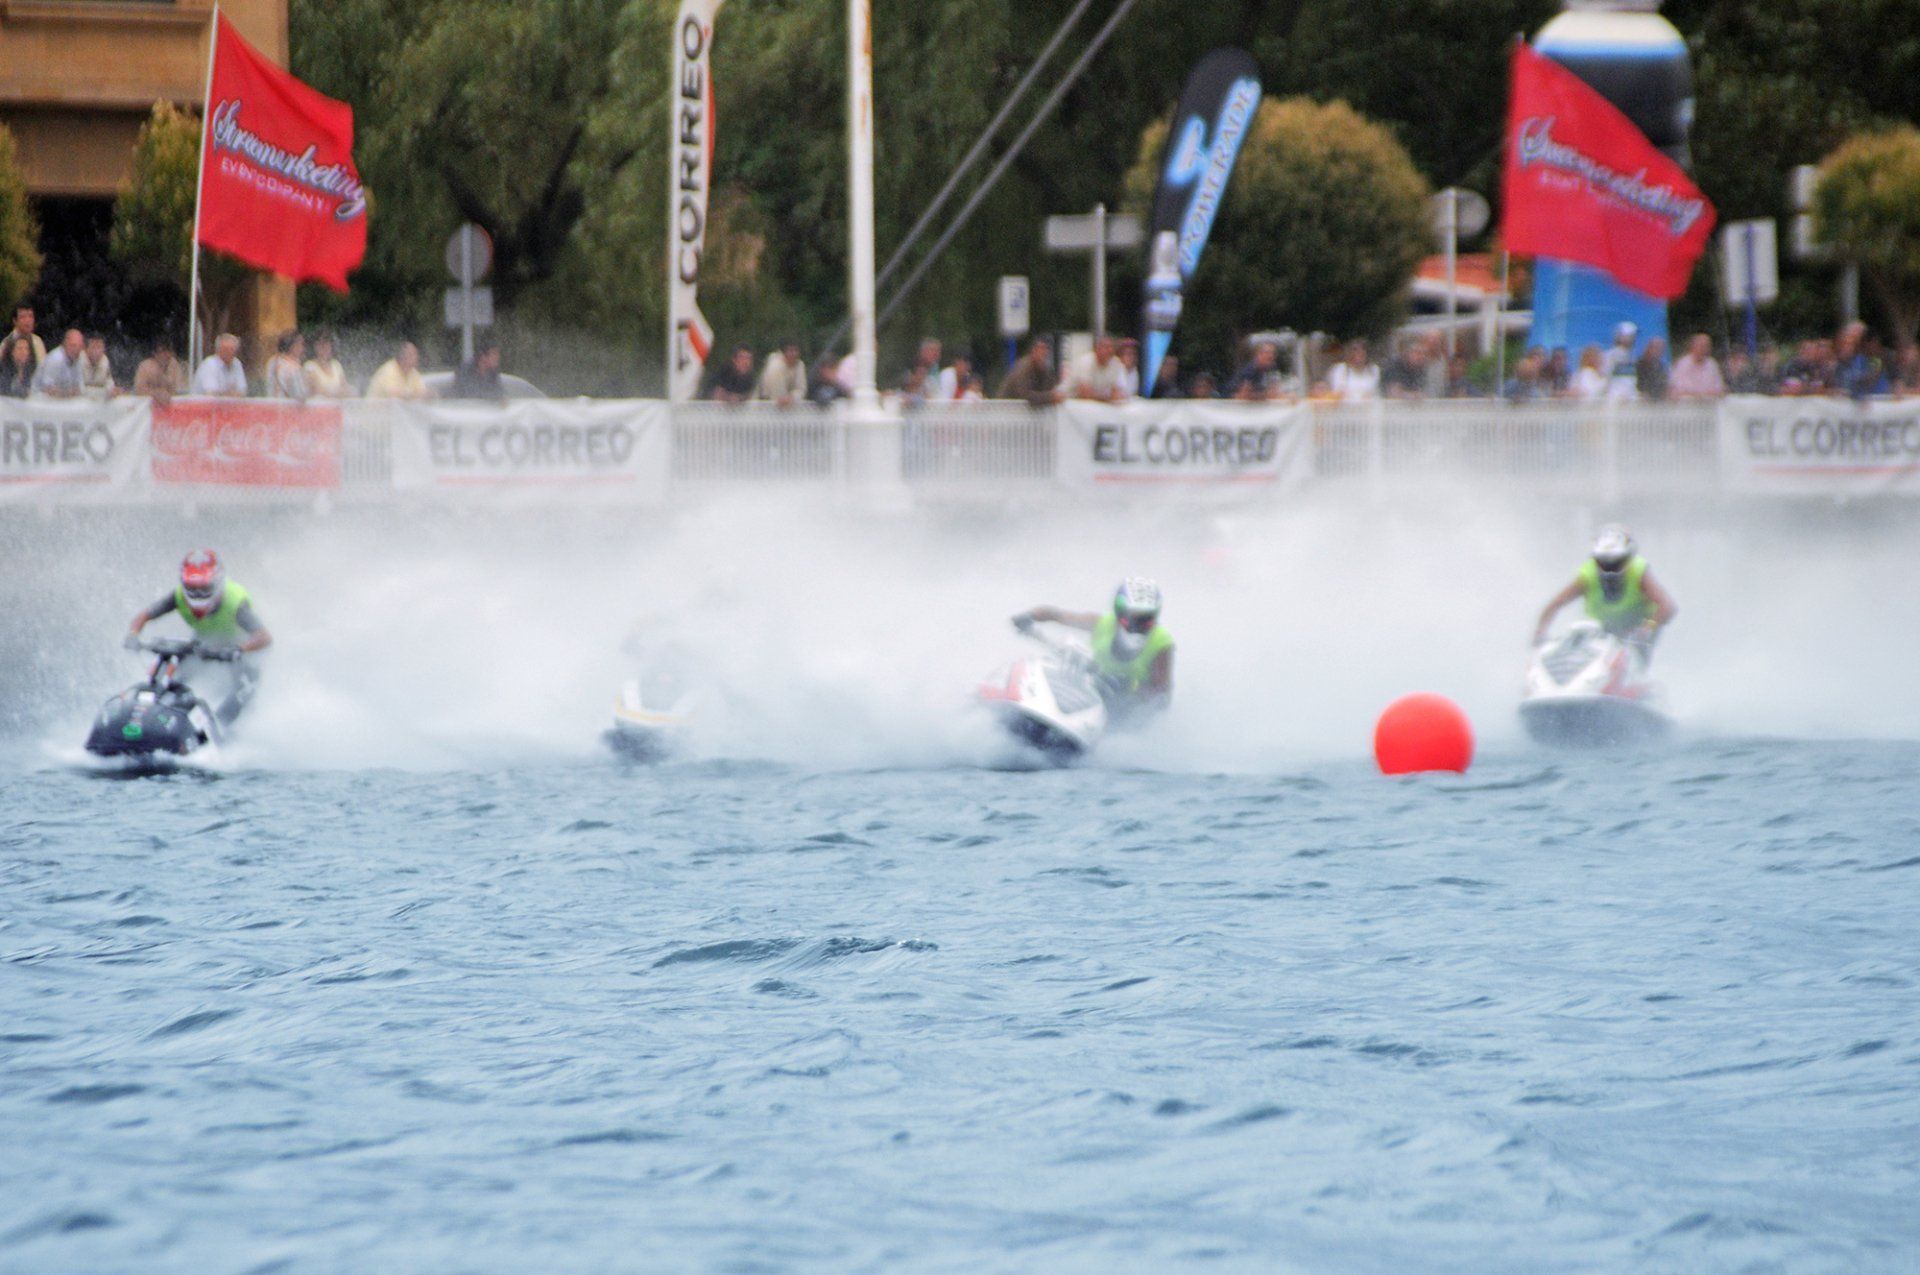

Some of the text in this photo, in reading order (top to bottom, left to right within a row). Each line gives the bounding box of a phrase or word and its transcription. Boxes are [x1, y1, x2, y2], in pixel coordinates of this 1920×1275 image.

[678, 12, 703, 286] CORREO
[429, 422, 635, 468] EL CORREO
[1093, 423, 1279, 465] EL CORREO
[1746, 416, 1787, 456] EL
